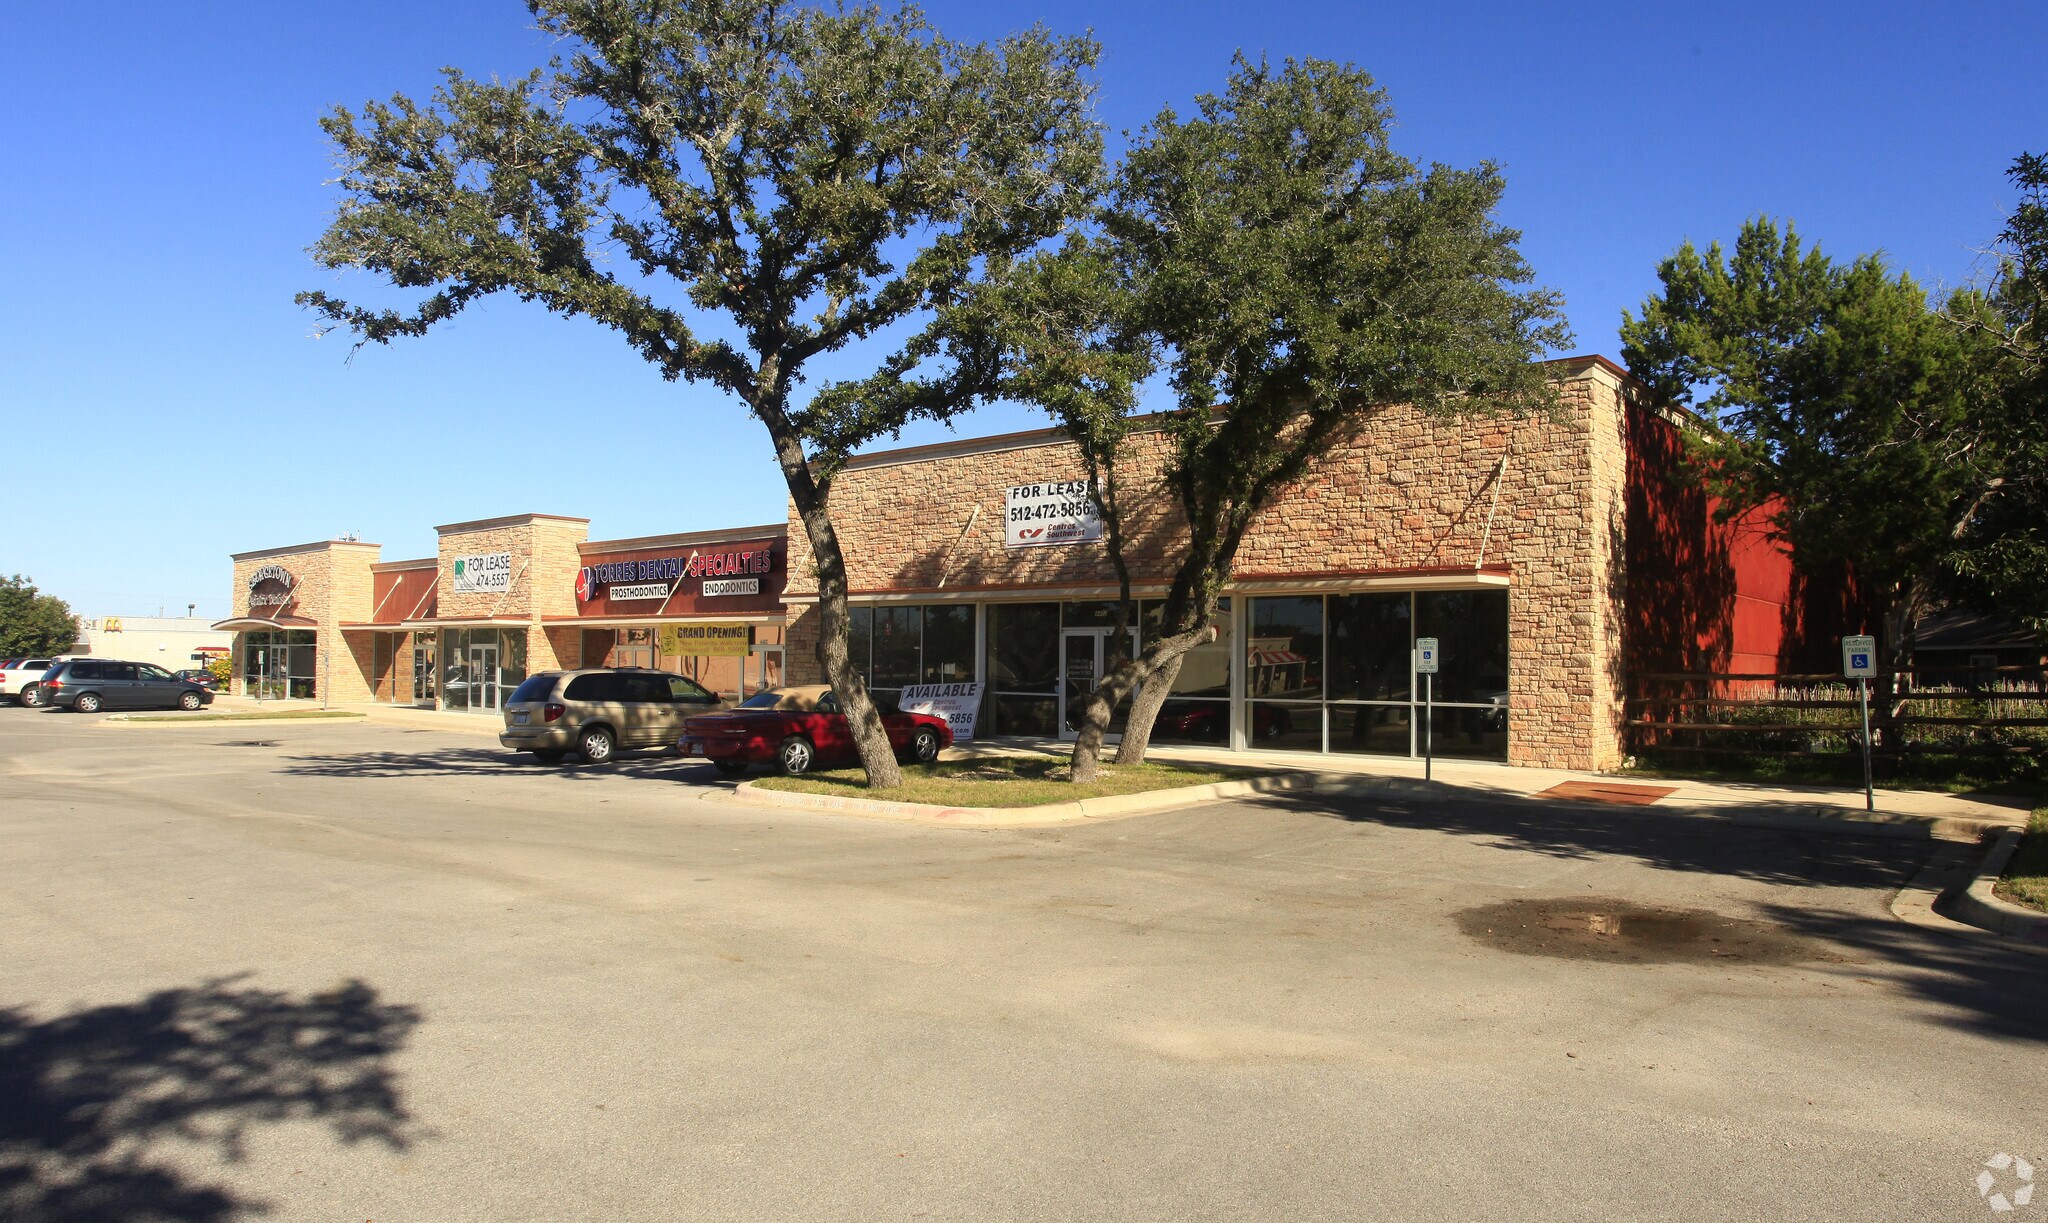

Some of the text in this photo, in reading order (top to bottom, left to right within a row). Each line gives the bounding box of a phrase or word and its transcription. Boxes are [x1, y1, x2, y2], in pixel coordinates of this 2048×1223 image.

[1013, 485, 1041, 499] FOR
[1011, 500, 1091, 521] 512-472-5856
[1046, 529, 1086, 539] Southwest
[1048, 523, 1076, 531] Centres
[469, 555, 510, 571] FOR LEASE
[594, 549, 771, 583] TORRES DENTAL SPECIALTIES
[249, 565, 291, 590] GEORGETOWN
[476, 573, 510, 587] 474-5557
[611, 585, 667, 598] PROSTHODONTICS
[704, 580, 757, 594] ENDODONTICS
[677, 625, 746, 639] GRAND OPENING!
[906, 684, 977, 699] AVAILABLE
